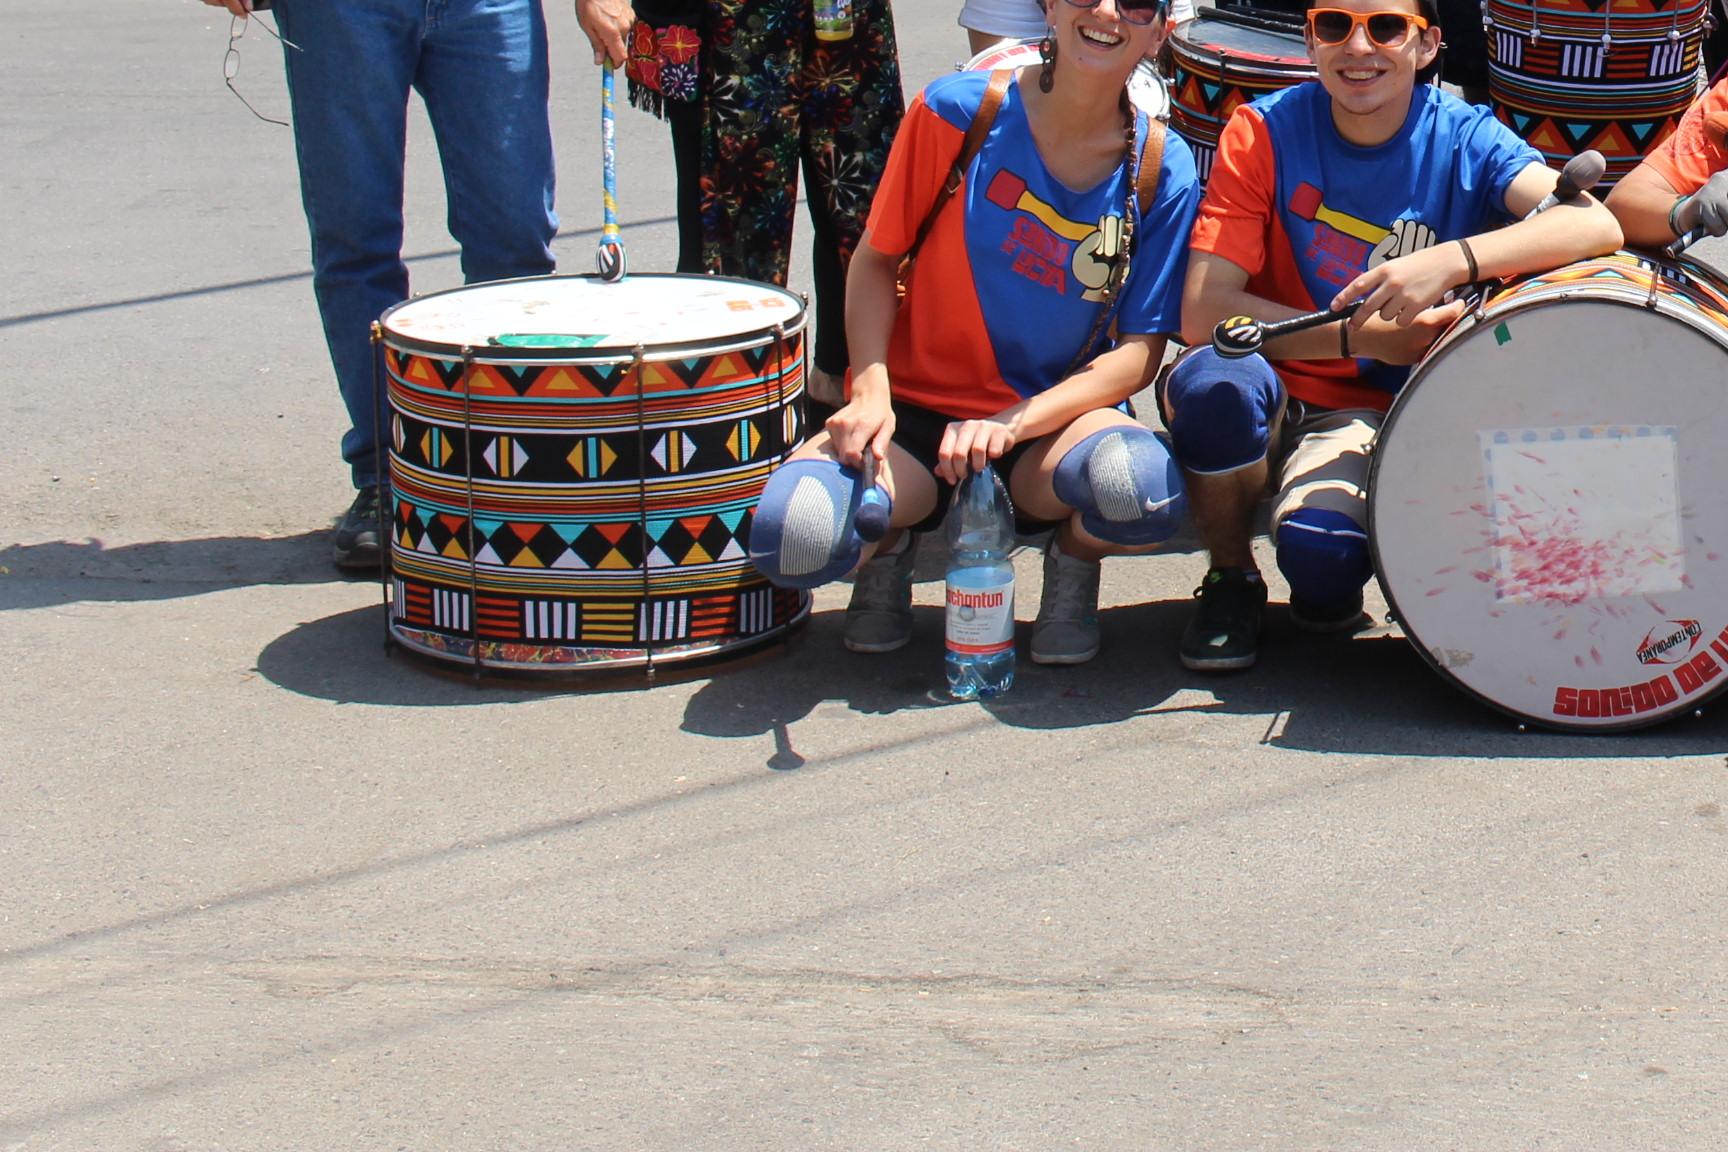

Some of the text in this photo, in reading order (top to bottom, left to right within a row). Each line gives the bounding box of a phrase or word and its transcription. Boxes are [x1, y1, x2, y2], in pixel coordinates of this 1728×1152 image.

[946, 589, 1004, 609] achantun
[1553, 675, 1679, 718] SONIDO
[1672, 650, 1723, 695] DE
